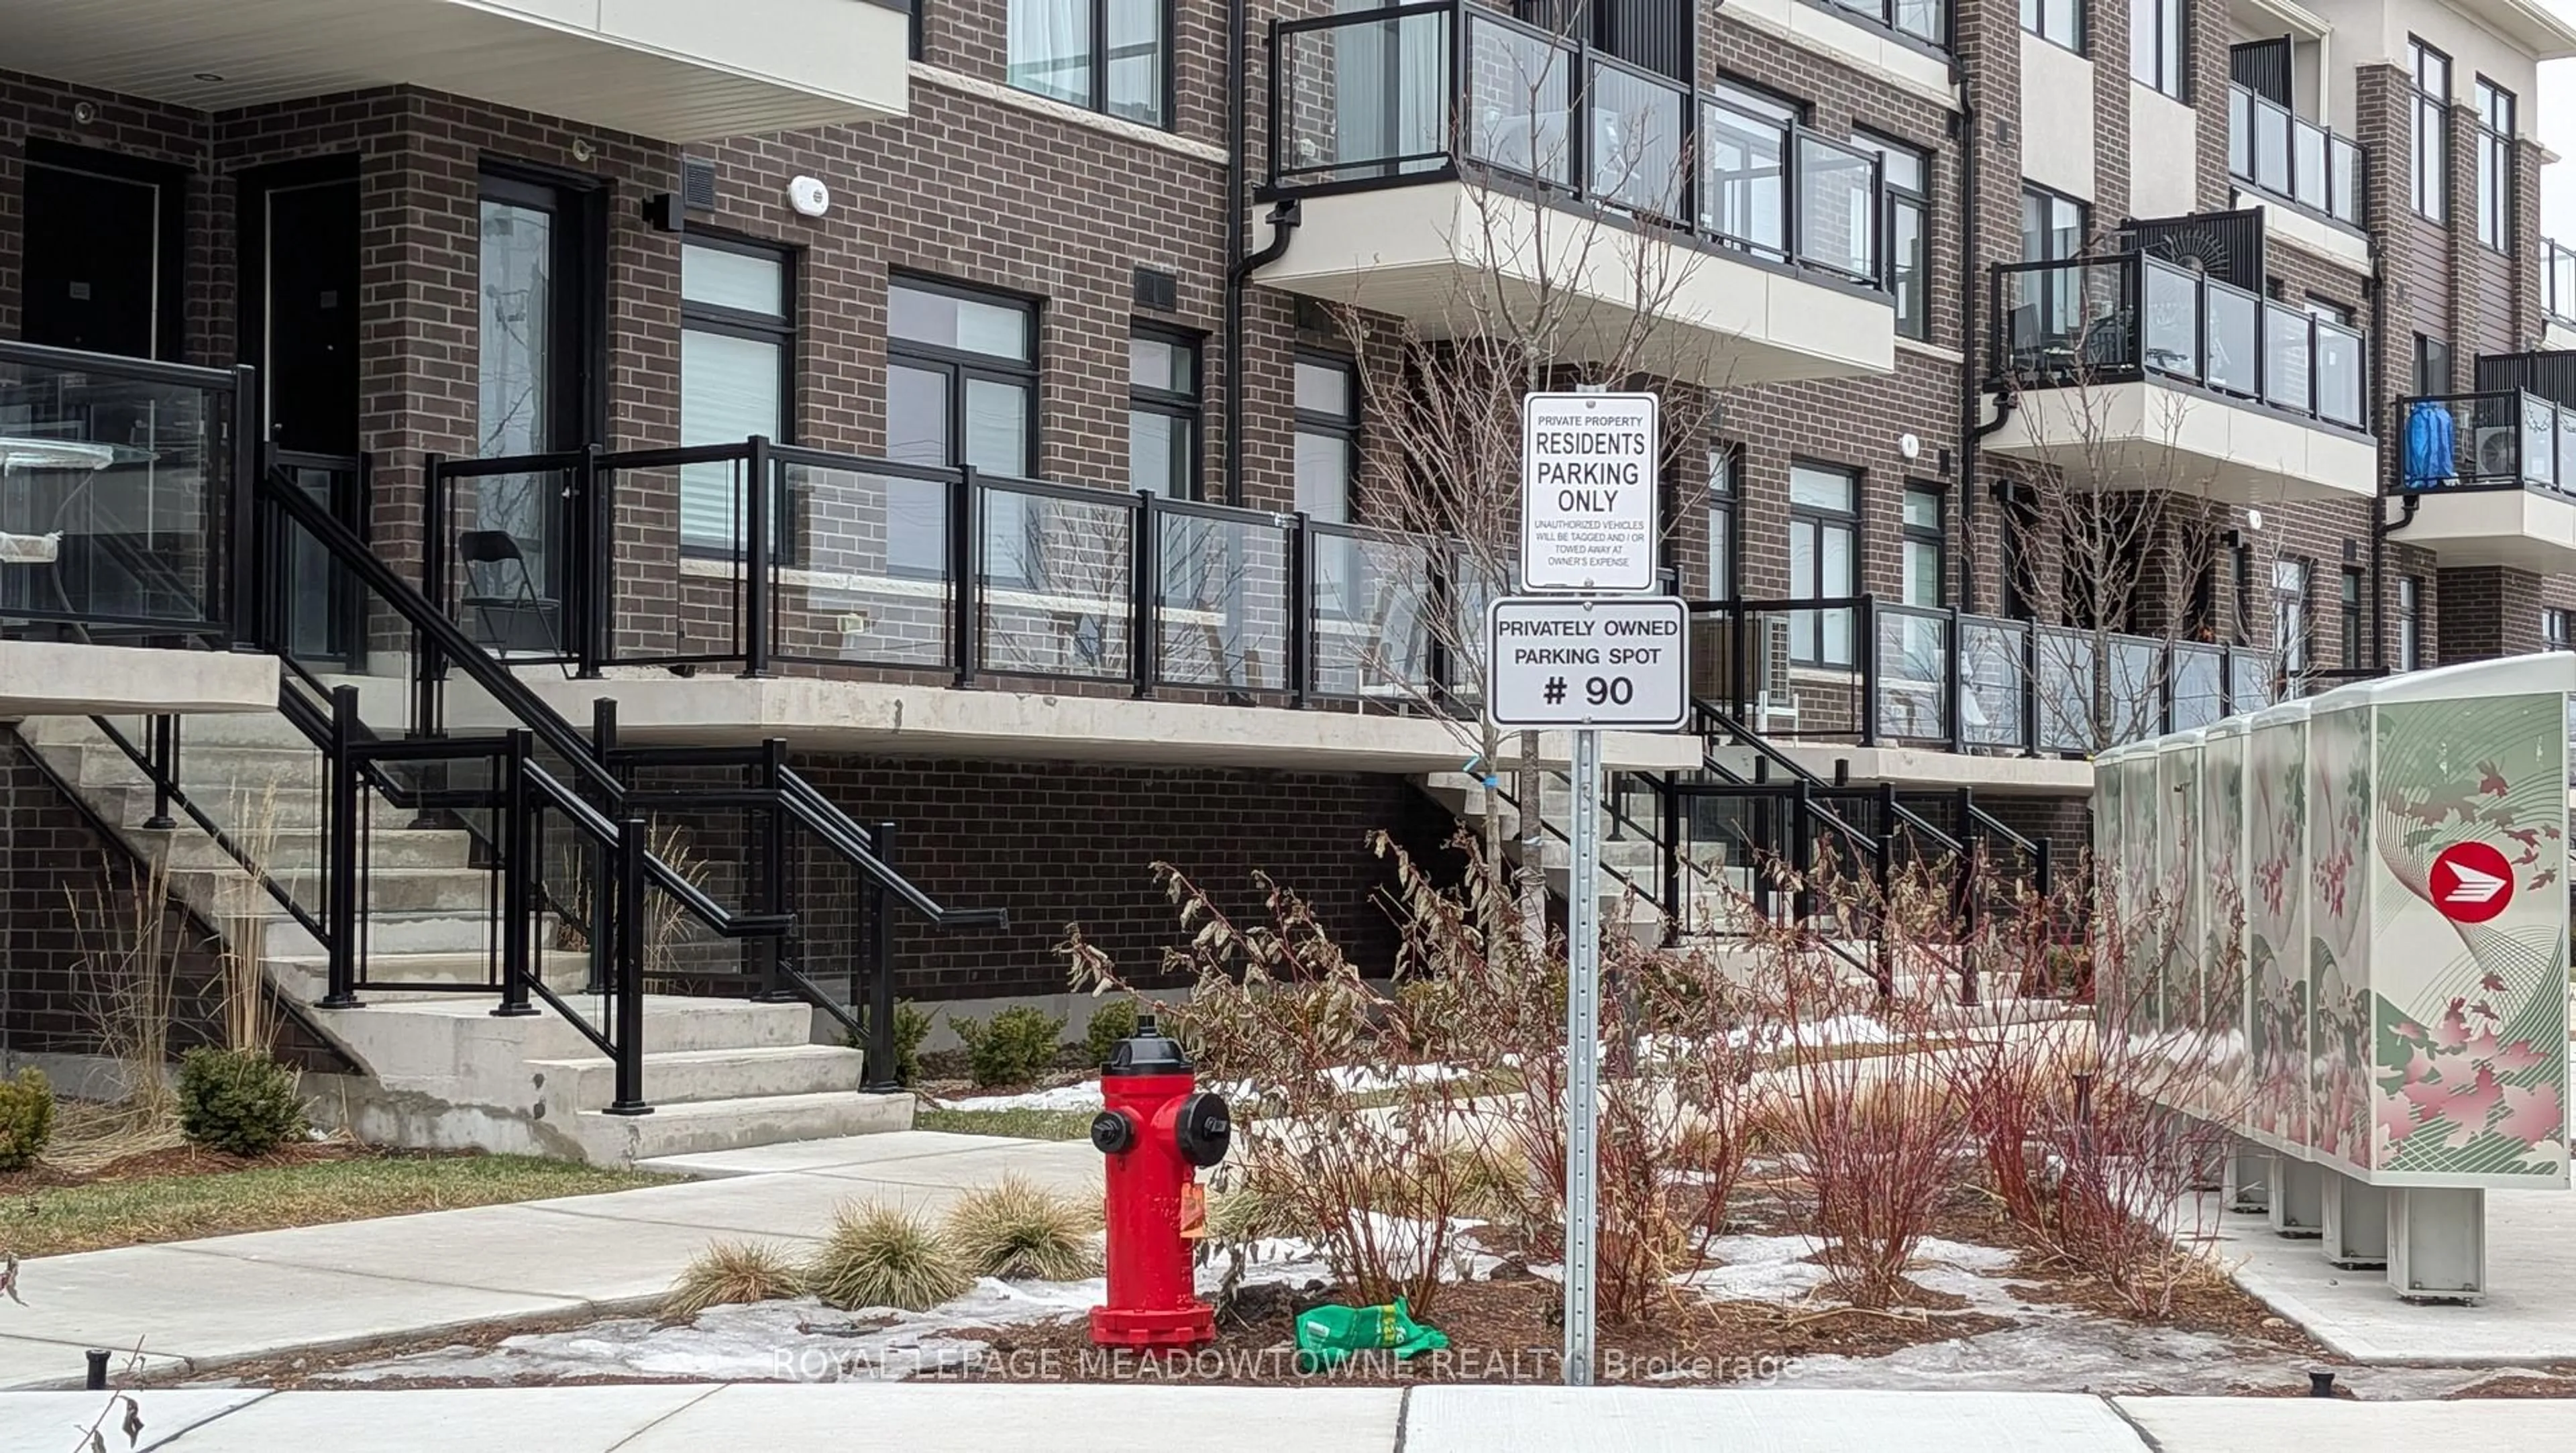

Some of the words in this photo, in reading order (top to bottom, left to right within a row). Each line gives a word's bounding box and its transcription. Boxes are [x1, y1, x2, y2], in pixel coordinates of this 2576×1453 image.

[1538, 416, 1582, 426] PRIVATE
[1585, 416, 1644, 426] PROPERTY
[1536, 432, 1645, 455] RESIDENTS
[1538, 462, 1638, 485] PARKING
[1558, 490, 1619, 512] ONLY
[1534, 520, 1601, 529] UNAUTHORIZED
[1603, 521, 1645, 529] VEHICLES
[1536, 533, 1556, 541] WILL
[1557, 533, 1568, 541] BE
[1571, 533, 1605, 542] TAGGED
[1607, 533, 1626, 542] AND
[1631, 533, 1645, 543] OR
[1556, 545, 1587, 553] TOWED
[1588, 545, 1611, 554] AWAY
[1612, 545, 1623, 555] AT
[1548, 557, 1589, 566] OWNER'S
[1589, 557, 1630, 568] EXPENSE
[1499, 621, 1596, 637] PRIVATELY
[1604, 621, 1678, 637] OWNED
[1514, 649, 1600, 664] PARKING
[1608, 648, 1662, 664] SPOT
[1542, 676, 1568, 705] #
[1585, 676, 1634, 706] 90
